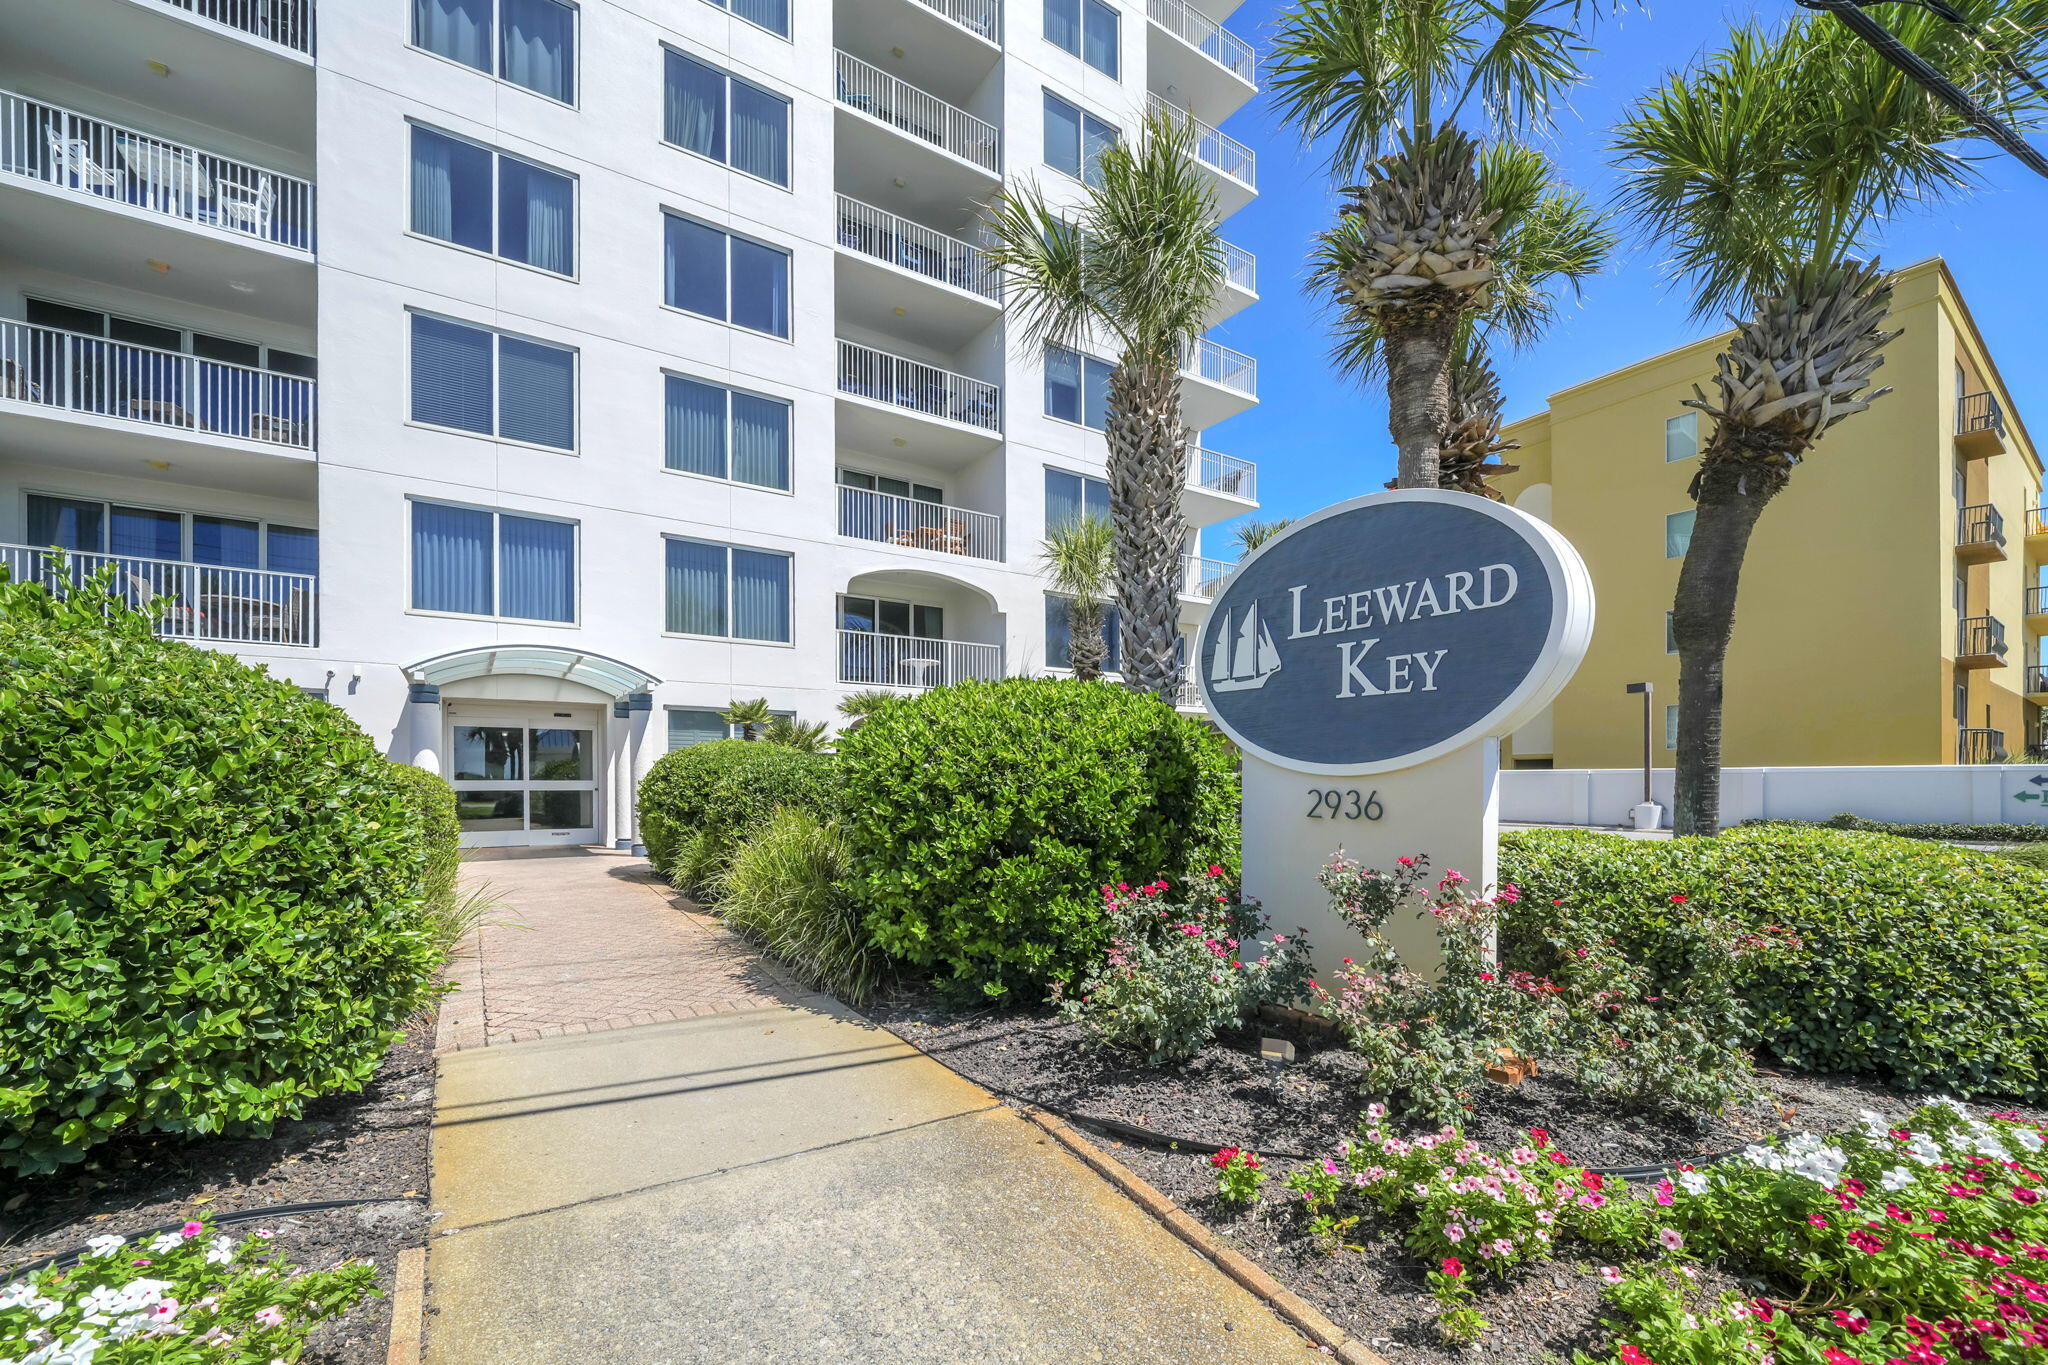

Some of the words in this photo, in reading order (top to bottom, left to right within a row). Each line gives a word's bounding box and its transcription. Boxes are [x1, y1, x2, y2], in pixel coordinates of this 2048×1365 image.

[1287, 563, 1518, 640] LEEWARD
[1335, 638, 1448, 699] KEY
[1306, 789, 1384, 821] 2936
